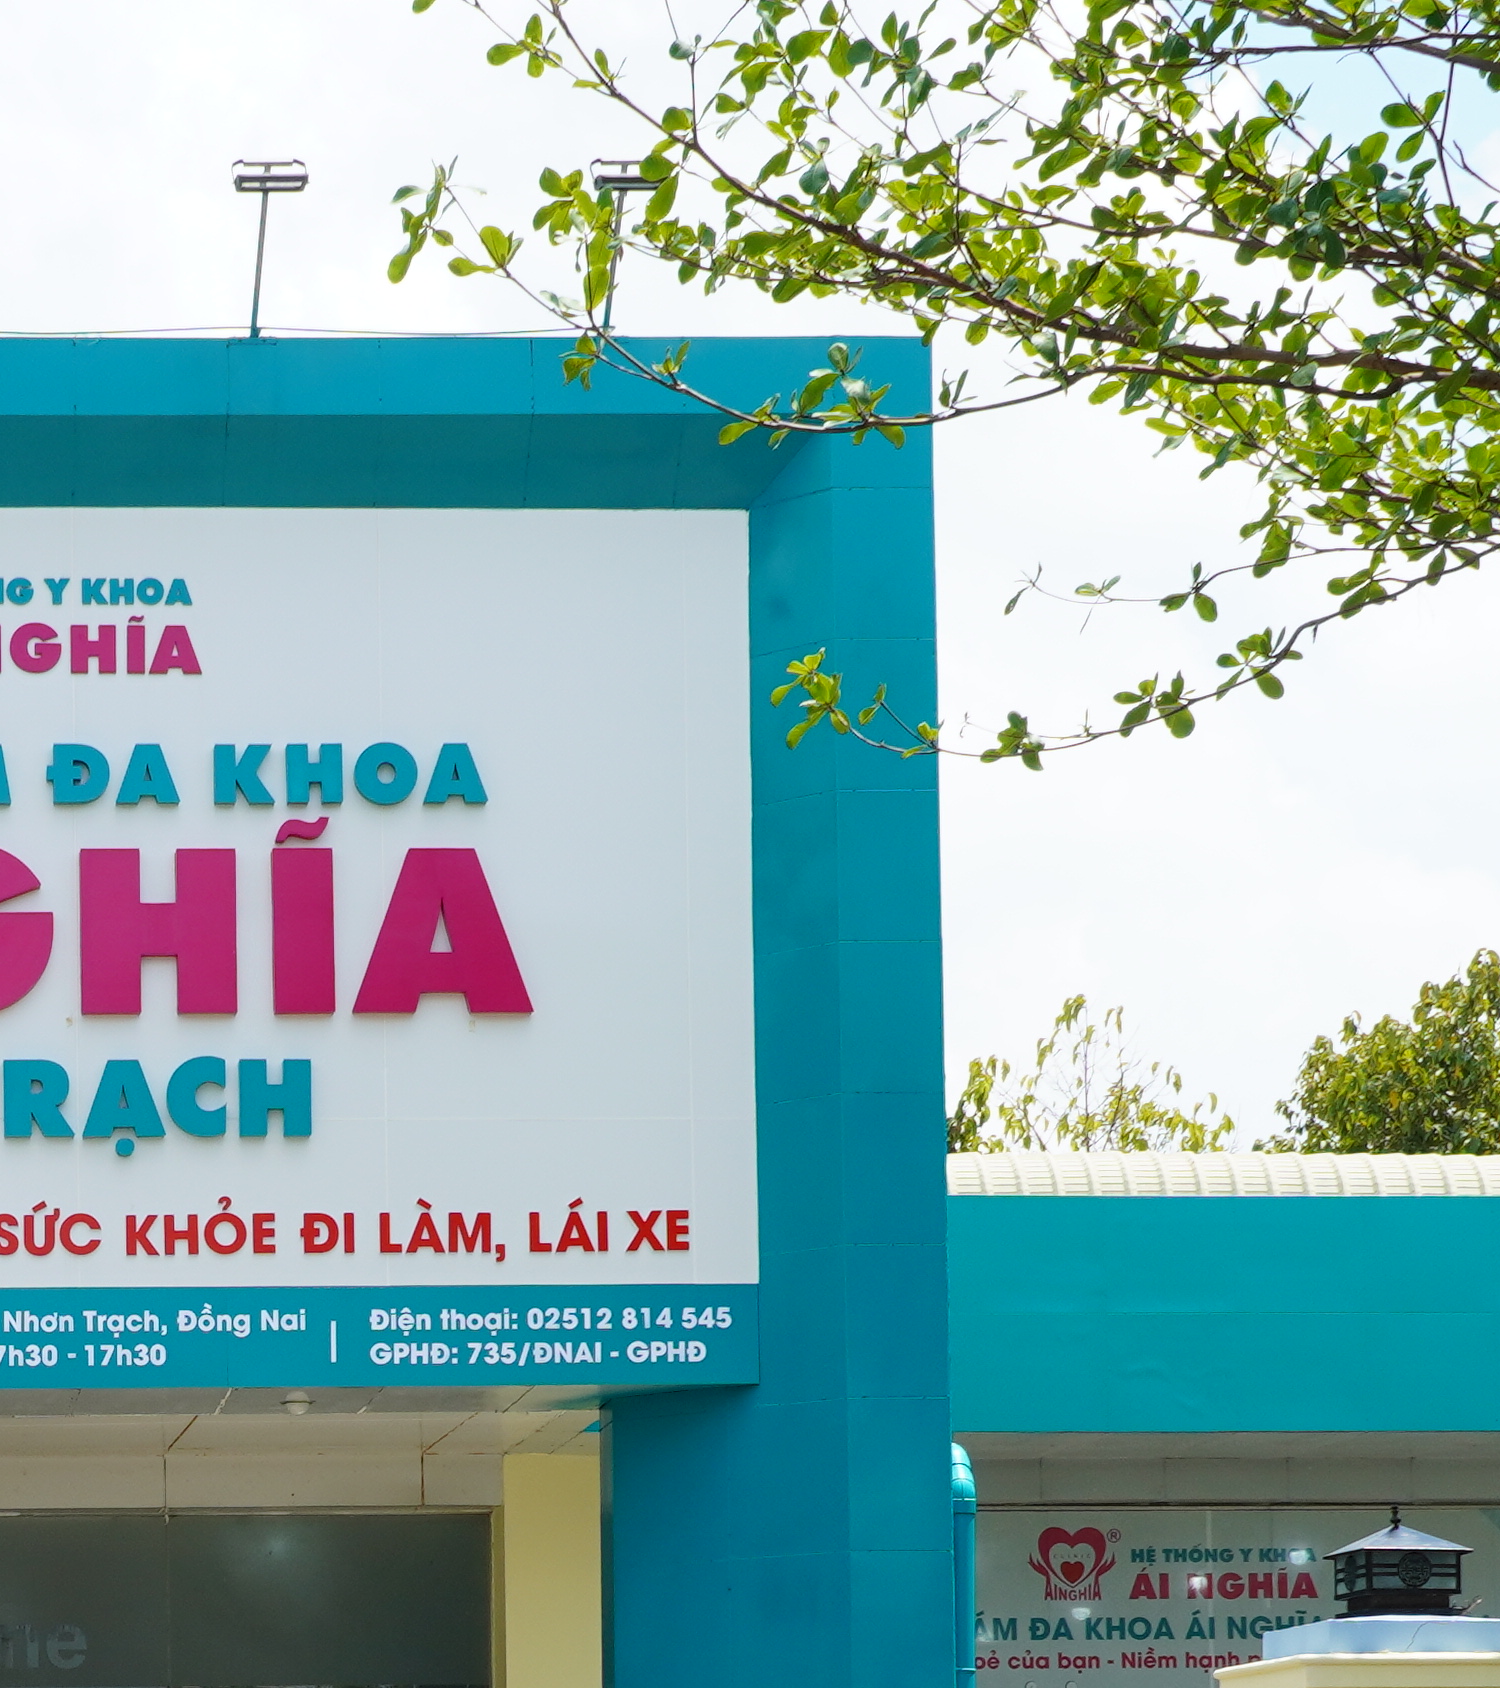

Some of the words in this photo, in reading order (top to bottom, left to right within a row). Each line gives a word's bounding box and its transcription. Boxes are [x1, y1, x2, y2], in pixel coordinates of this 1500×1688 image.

[45, 579, 69, 604] Y
[81, 578, 192, 604] KHOA
[46, 744, 180, 805] ĐA
[214, 743, 488, 806] KHOA
[126, 1196, 276, 1255] KHỎE
[300, 1212, 355, 1254] ĐI
[380, 1198, 506, 1262] LÀM,
[530, 1197, 608, 1253] LÁI
[628, 1210, 690, 1252] XE
[3, 1310, 74, 1333] Nhơn
[83, 1310, 168, 1339] Trạch,
[176, 1303, 250, 1339] Đồng
[260, 1308, 306, 1332] Nai
[369, 1306, 431, 1333] Điện
[440, 1307, 518, 1334] thoại:
[526, 1307, 612, 1331] 02512
[621, 1307, 673, 1330] 814
[681, 1306, 732, 1330] 545
[84, 1344, 167, 1367] 17h30
[369, 1342, 460, 1365] GPHĐ:
[467, 1340, 602, 1367] 735/ĐNAI
[626, 1340, 707, 1363] GPHĐ
[1130, 1545, 1157, 1567] HỆ
[1160, 1543, 1234, 1563] THỐNG
[1239, 1548, 1254, 1563] Y
[1044, 1583, 1102, 1601] AINGHIA
[1129, 1568, 1170, 1600] ÁI
[1187, 1567, 1319, 1599] NGHĨA
[975, 1610, 1018, 1641] ÁM
[1028, 1616, 1074, 1642] ĐA
[1086, 1616, 1176, 1641] KHOA
[1185, 1610, 1216, 1640] ÁI
[1227, 1610, 1322, 1640] NGH
[975, 1650, 999, 1669] oẻ
[1008, 1649, 1050, 1669] của
[1058, 1652, 1101, 1674] bạn
[1121, 1646, 1178, 1669] Niềm
[1185, 1651, 1240, 1671] hạnh
